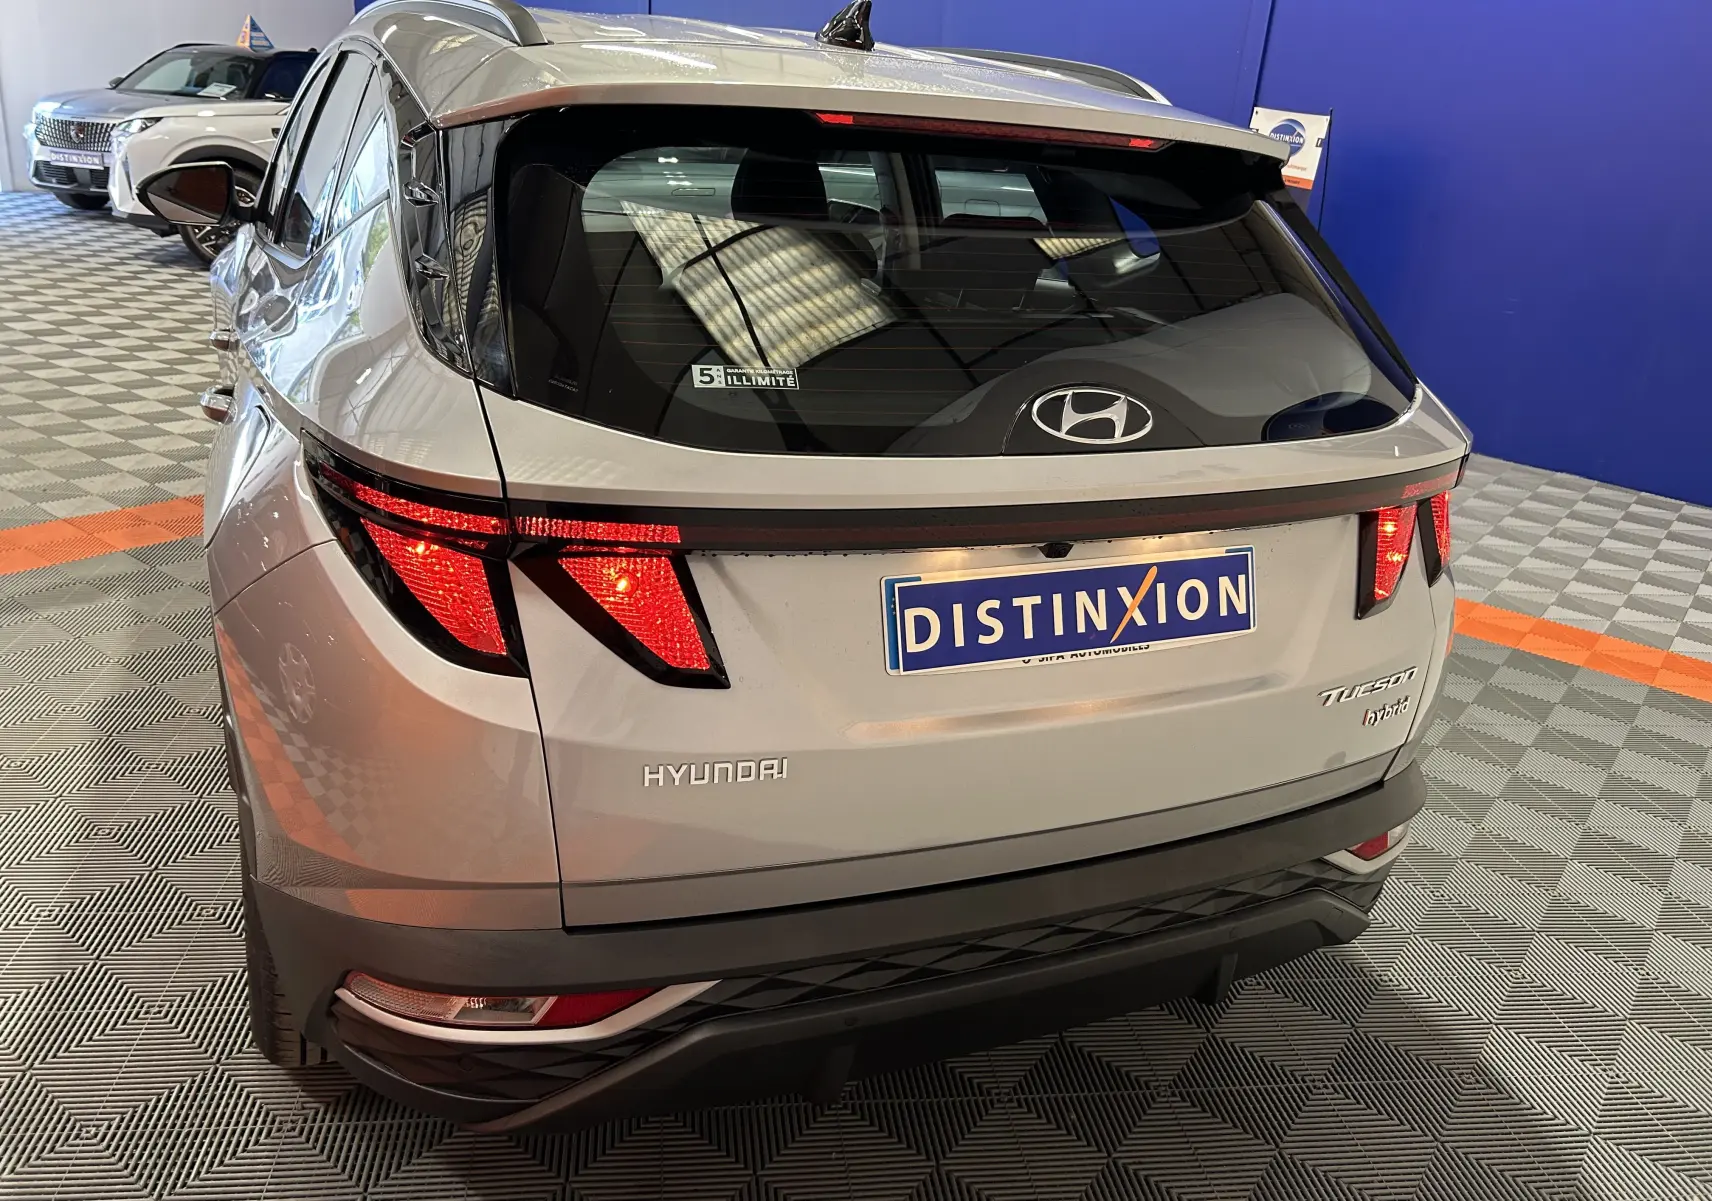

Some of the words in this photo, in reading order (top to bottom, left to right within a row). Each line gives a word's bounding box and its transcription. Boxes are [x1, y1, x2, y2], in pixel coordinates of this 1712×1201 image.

[699, 367, 715, 385] 5
[727, 374, 796, 387] ILLIMITÉ
[903, 566, 1248, 653] DISTINXION
[1362, 695, 1411, 727] hybrid
[643, 757, 788, 787] HYUNDAI
